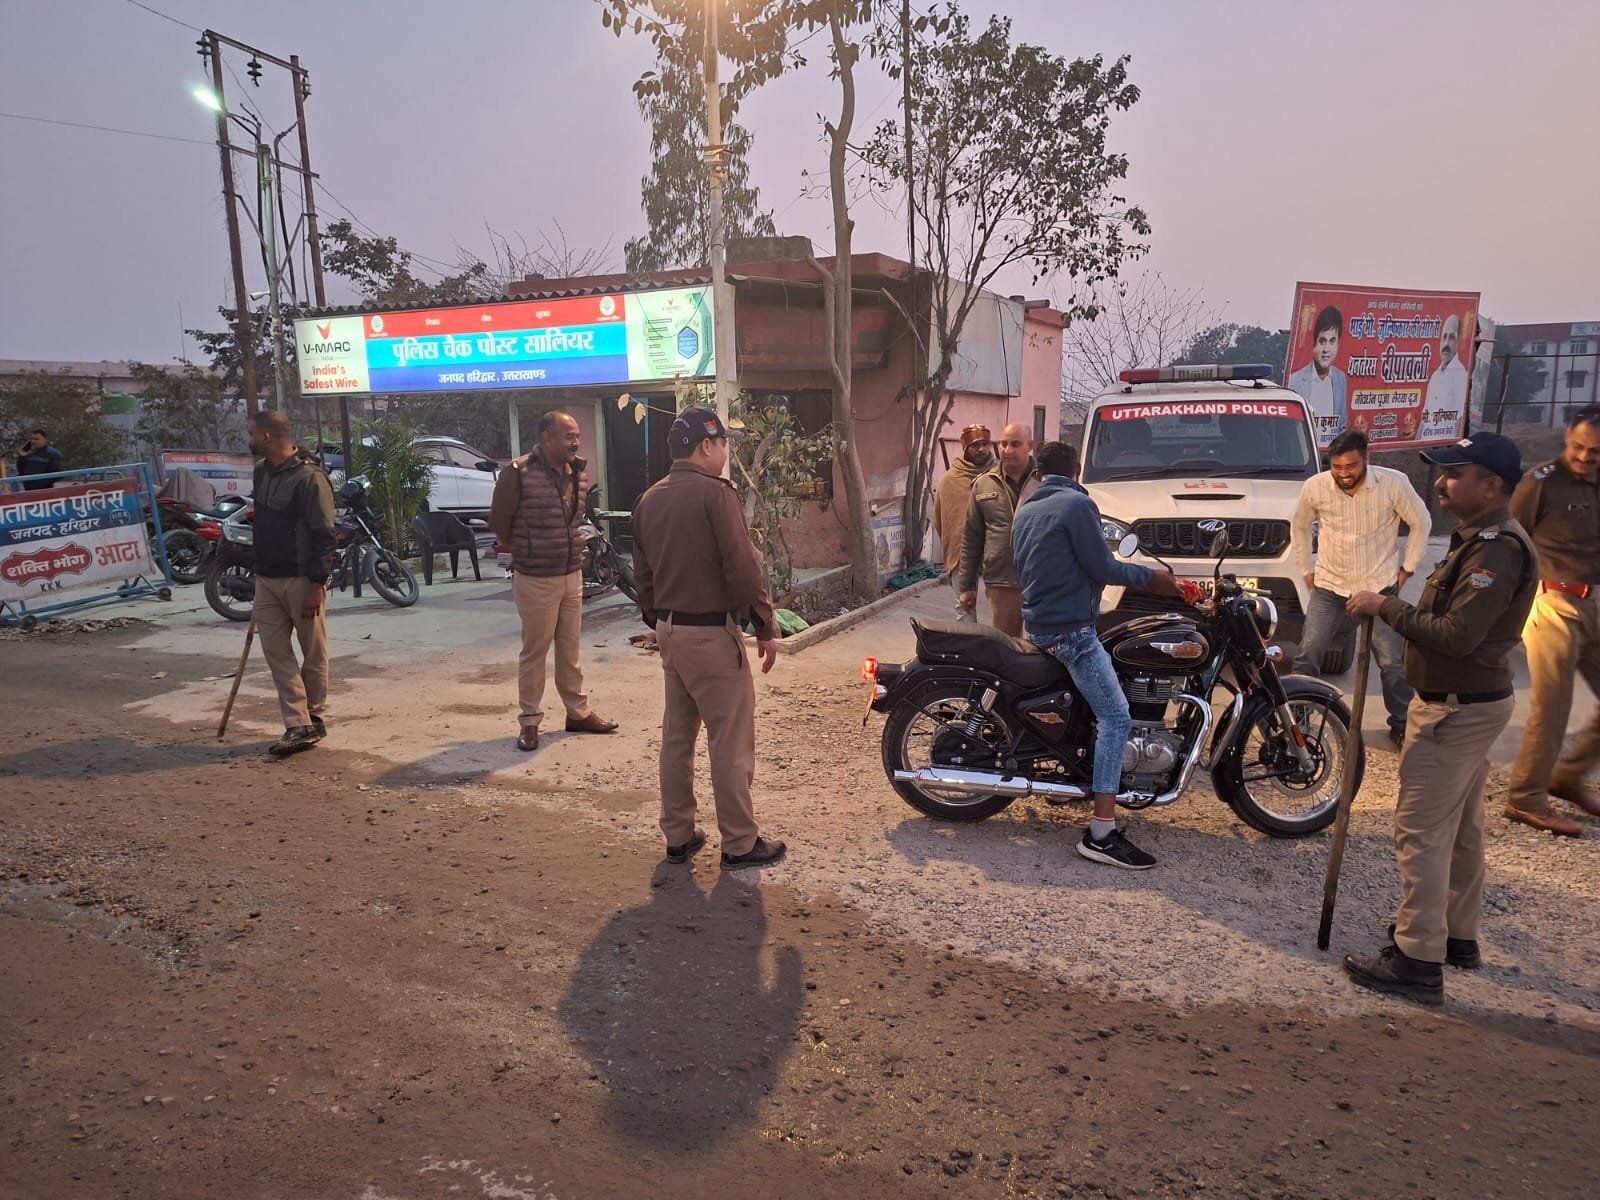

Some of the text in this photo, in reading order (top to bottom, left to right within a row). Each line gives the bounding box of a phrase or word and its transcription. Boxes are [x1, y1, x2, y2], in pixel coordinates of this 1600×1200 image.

[303, 341, 351, 354] V-MARC
[391, 336, 440, 366] पुलिस
[476, 331, 519, 356] पोस्ट
[523, 327, 595, 354] सालियर
[312, 363, 346, 375] India's
[1381, 343, 1431, 383] दीपावली
[303, 377, 358, 389] Safest Wire
[438, 373, 465, 383] जनपद
[1112, 404, 1288, 419] UTTARAKHAND POLICE
[69, 489, 124, 517] पुलिस
[95, 540, 141, 566] आटा
[7, 554, 86, 577] शक्ति भोग
